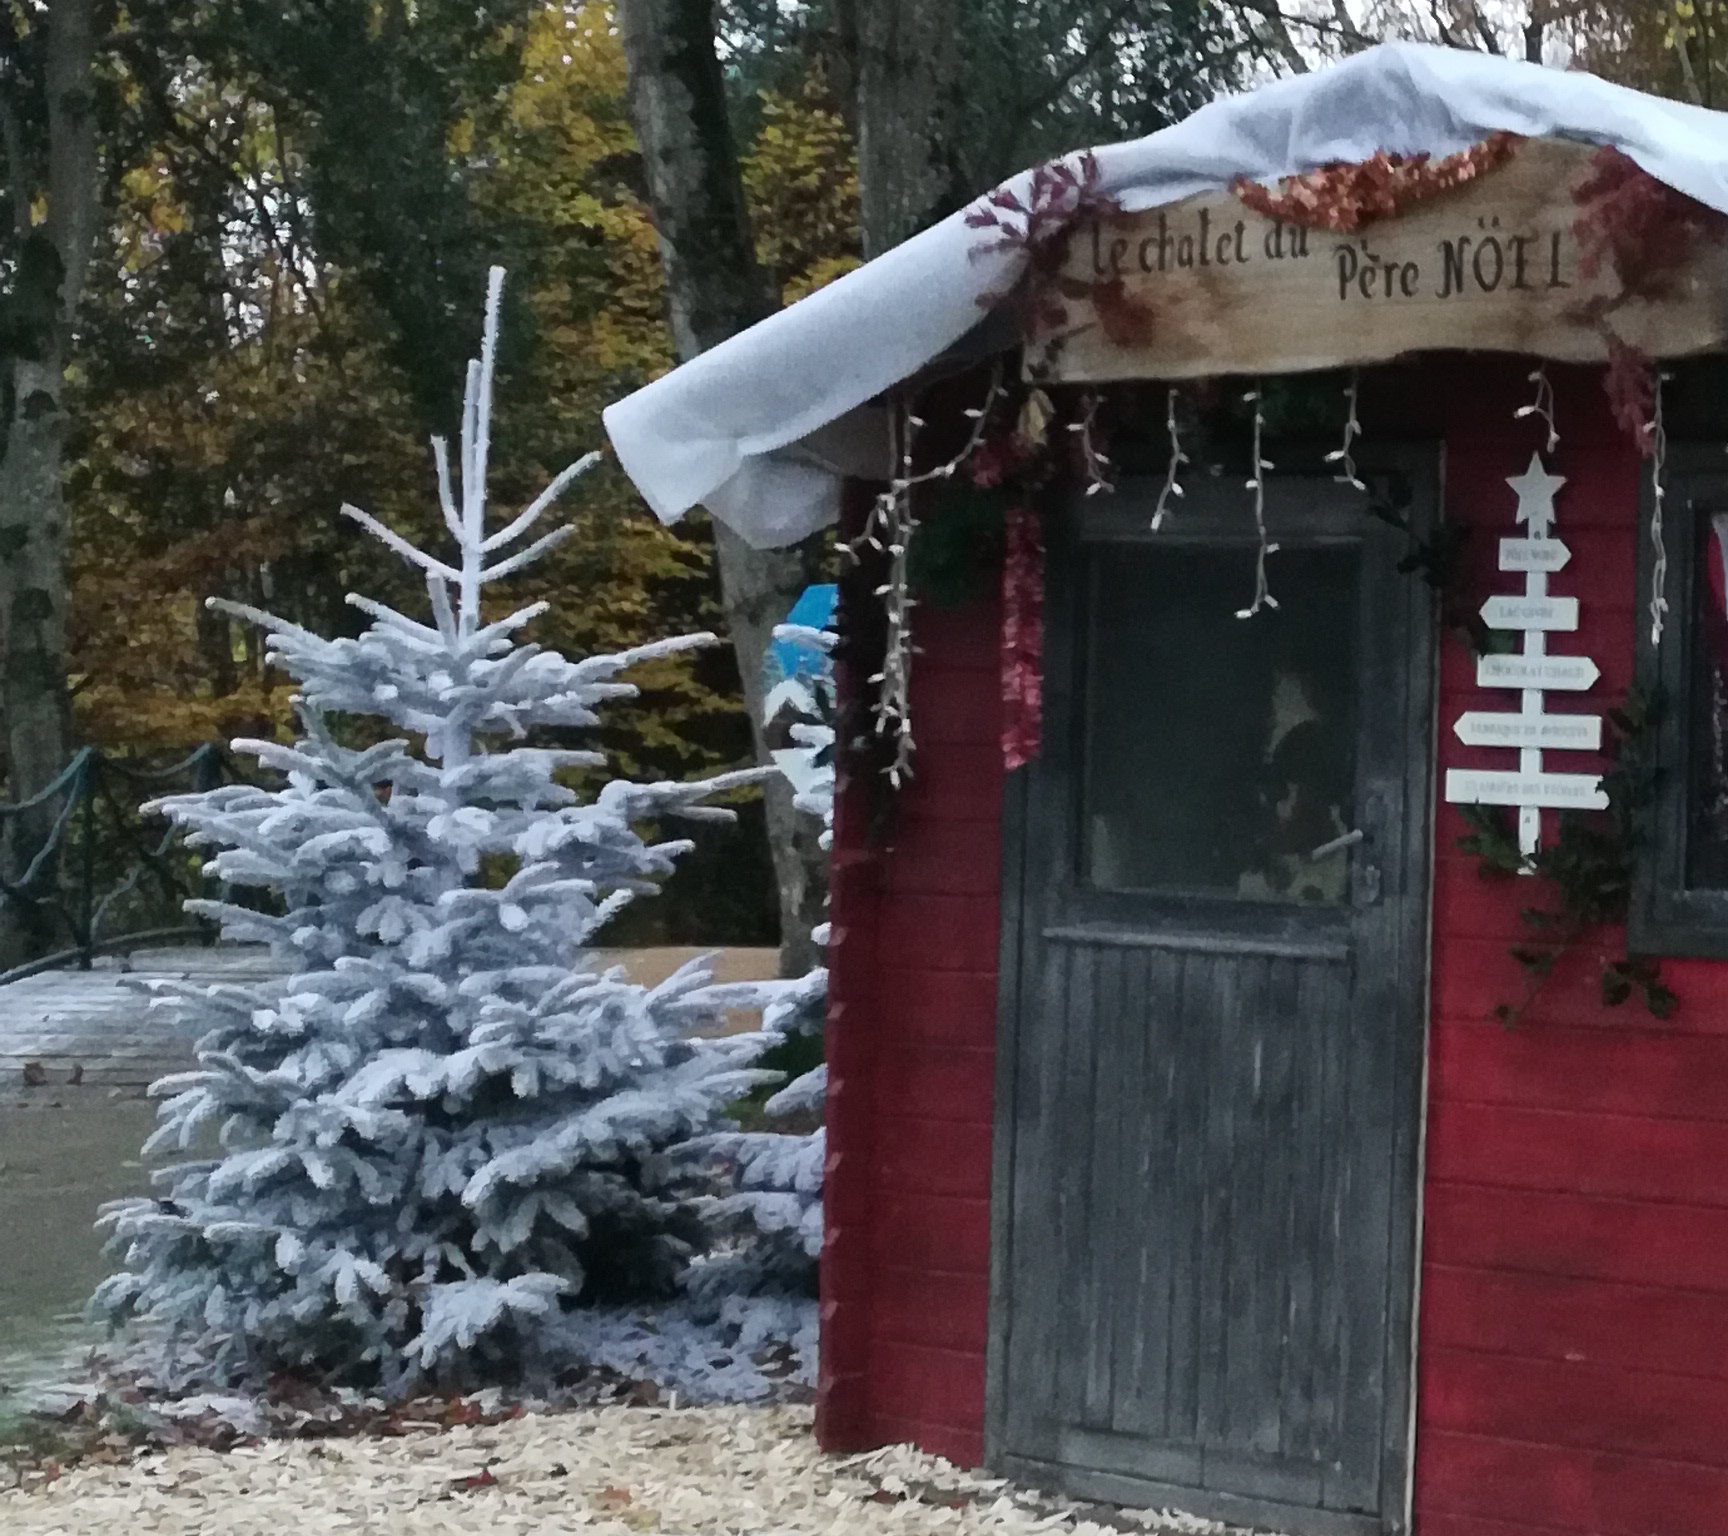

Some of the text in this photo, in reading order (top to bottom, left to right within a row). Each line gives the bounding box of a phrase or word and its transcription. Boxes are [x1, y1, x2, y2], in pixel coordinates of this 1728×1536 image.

[1139, 207, 1249, 272] chalet
[1263, 216, 1310, 260] du
[1334, 238, 1419, 301] Père
